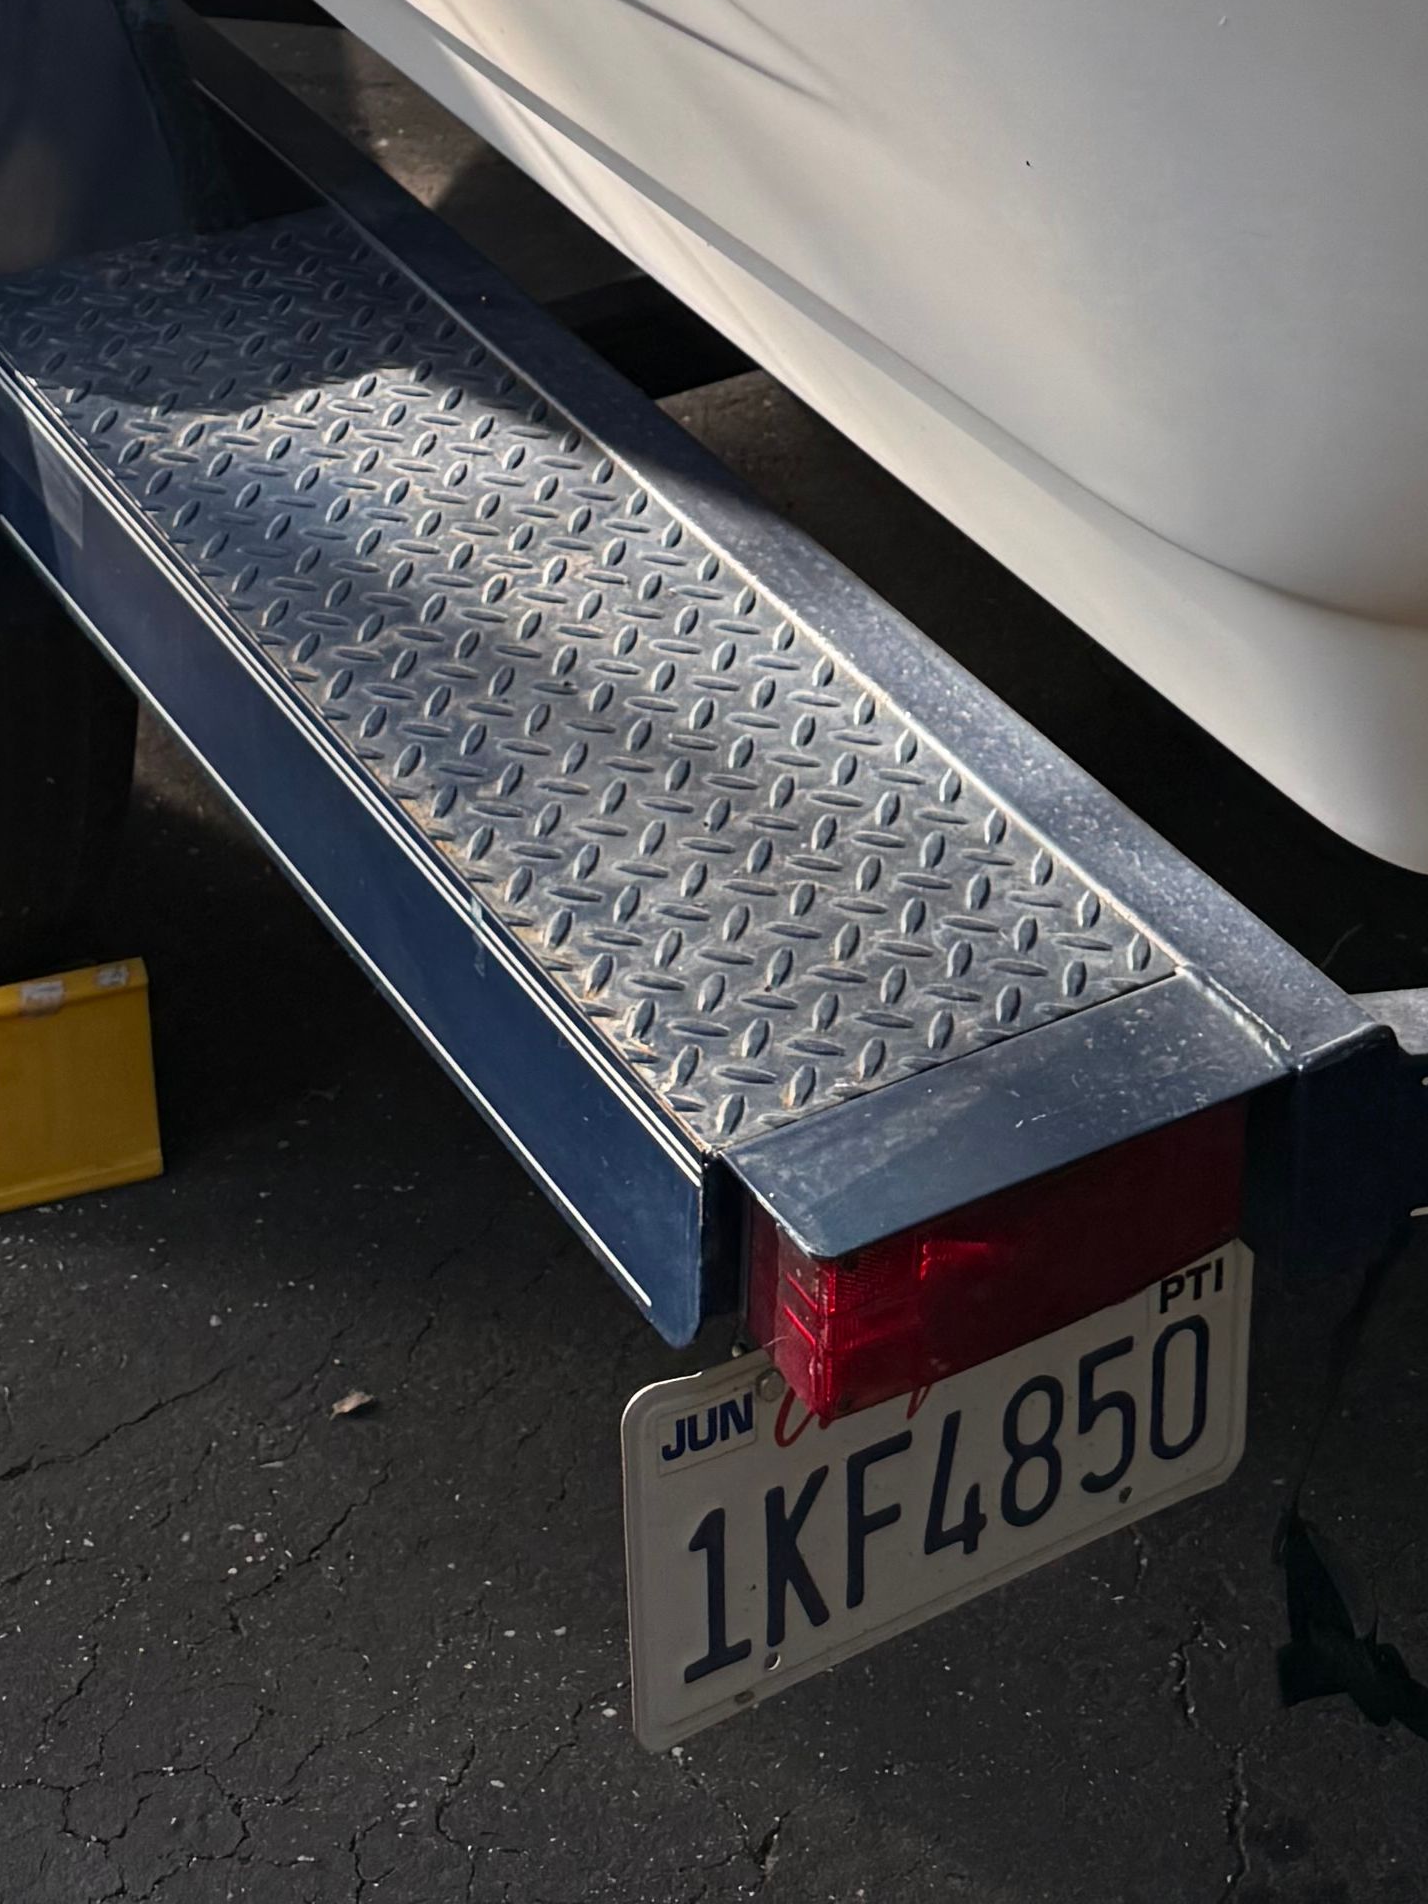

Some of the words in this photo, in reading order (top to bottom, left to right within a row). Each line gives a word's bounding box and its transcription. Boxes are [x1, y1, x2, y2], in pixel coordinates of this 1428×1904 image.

[1159, 1257, 1224, 1315] PTI
[661, 1391, 754, 1462] JUN
[684, 1314, 1209, 1684] 1KF4850
